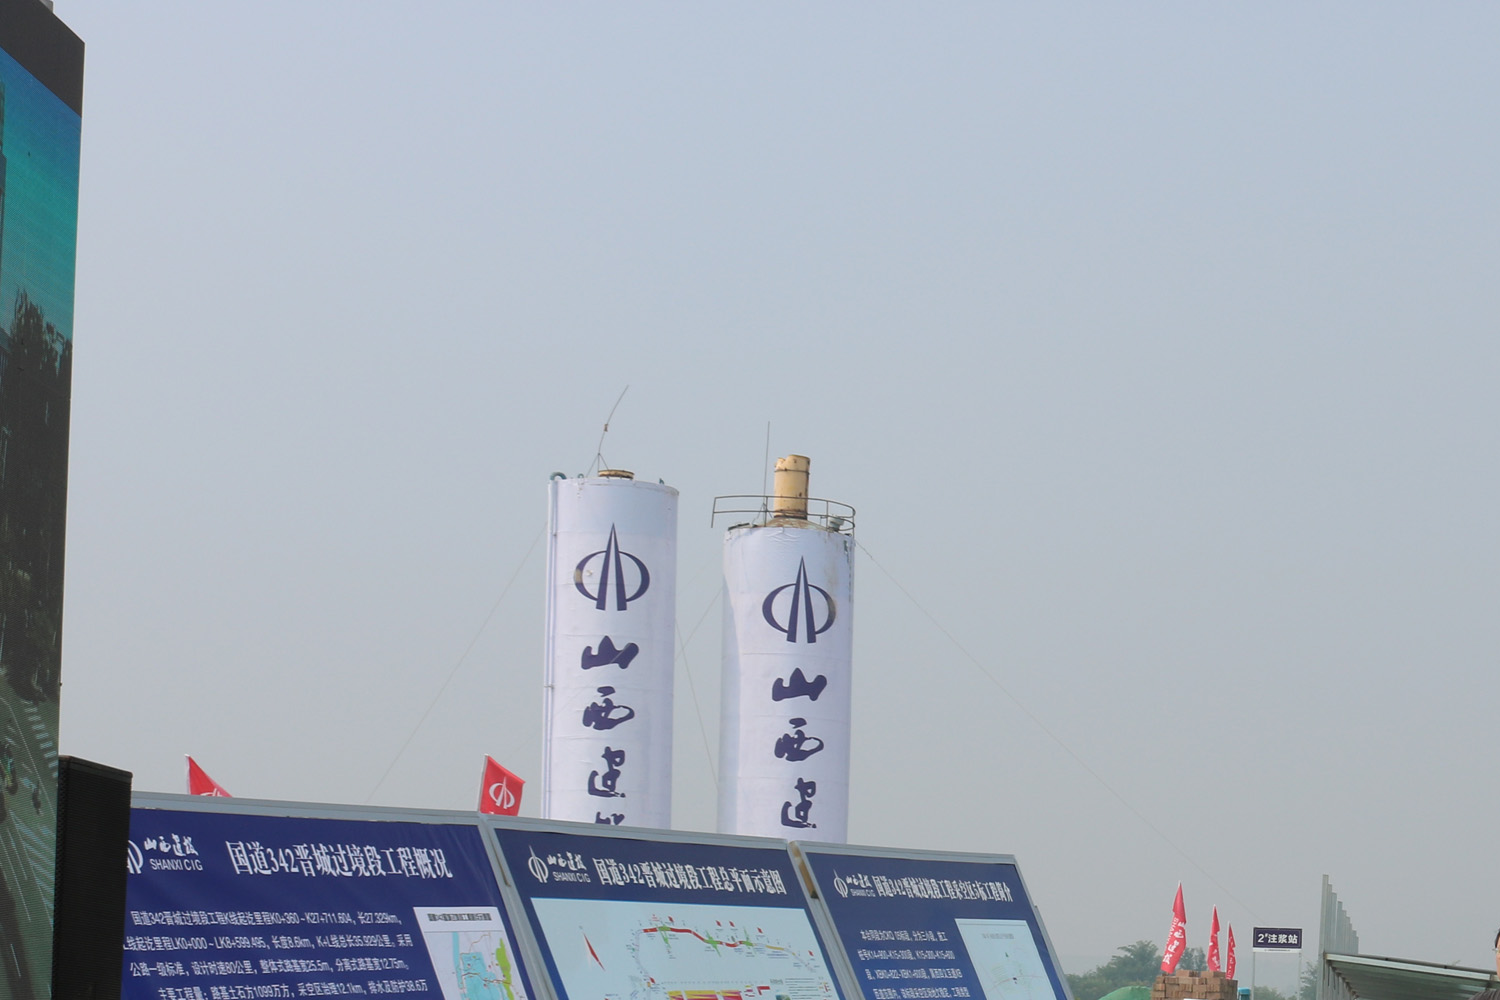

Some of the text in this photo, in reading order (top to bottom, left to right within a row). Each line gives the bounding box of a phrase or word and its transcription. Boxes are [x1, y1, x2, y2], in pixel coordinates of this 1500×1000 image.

[150, 858, 203, 871] SHANXI CIG
[225, 840, 454, 880] 国道342晋城过境段工程概况
[592, 857, 787, 895] 国道342晋城过境段工程总平面示意图
